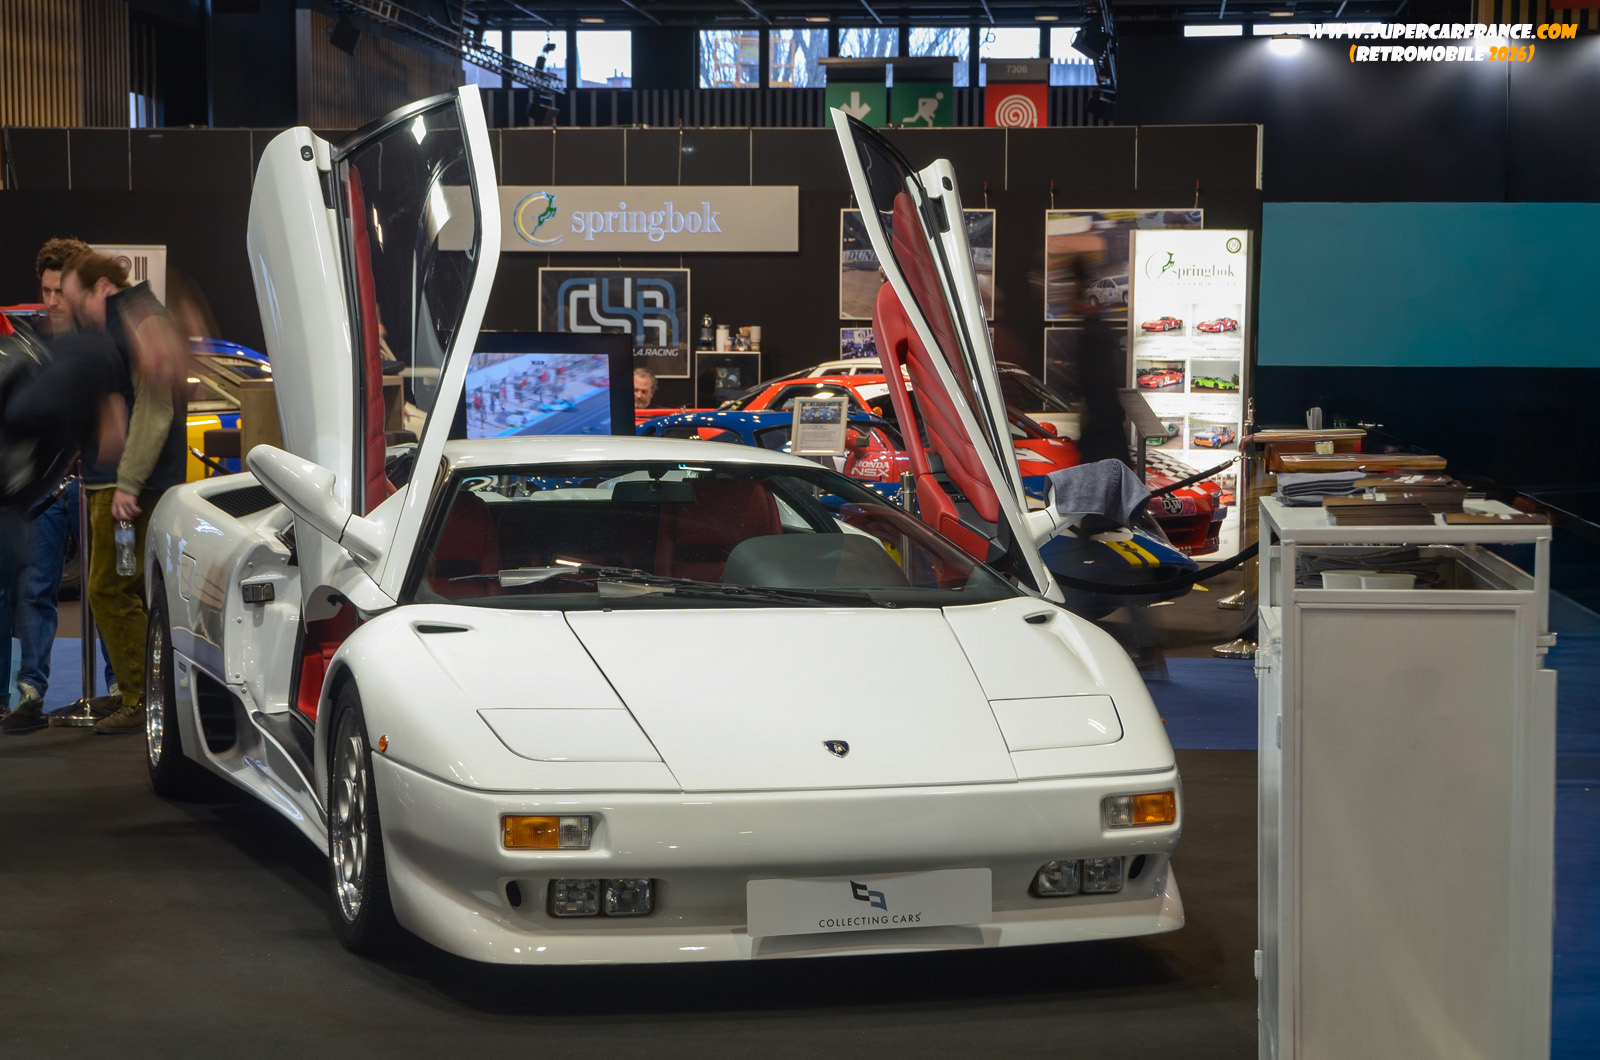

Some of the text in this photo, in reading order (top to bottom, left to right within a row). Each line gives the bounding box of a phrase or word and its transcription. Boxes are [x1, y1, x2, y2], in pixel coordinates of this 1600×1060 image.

[1006, 64, 1028, 74] 7306
[571, 201, 722, 242] springbok
[855, 460, 890, 469] HONDA
[851, 466, 890, 478] NSX
[818, 916, 889, 928] COLLECTING
